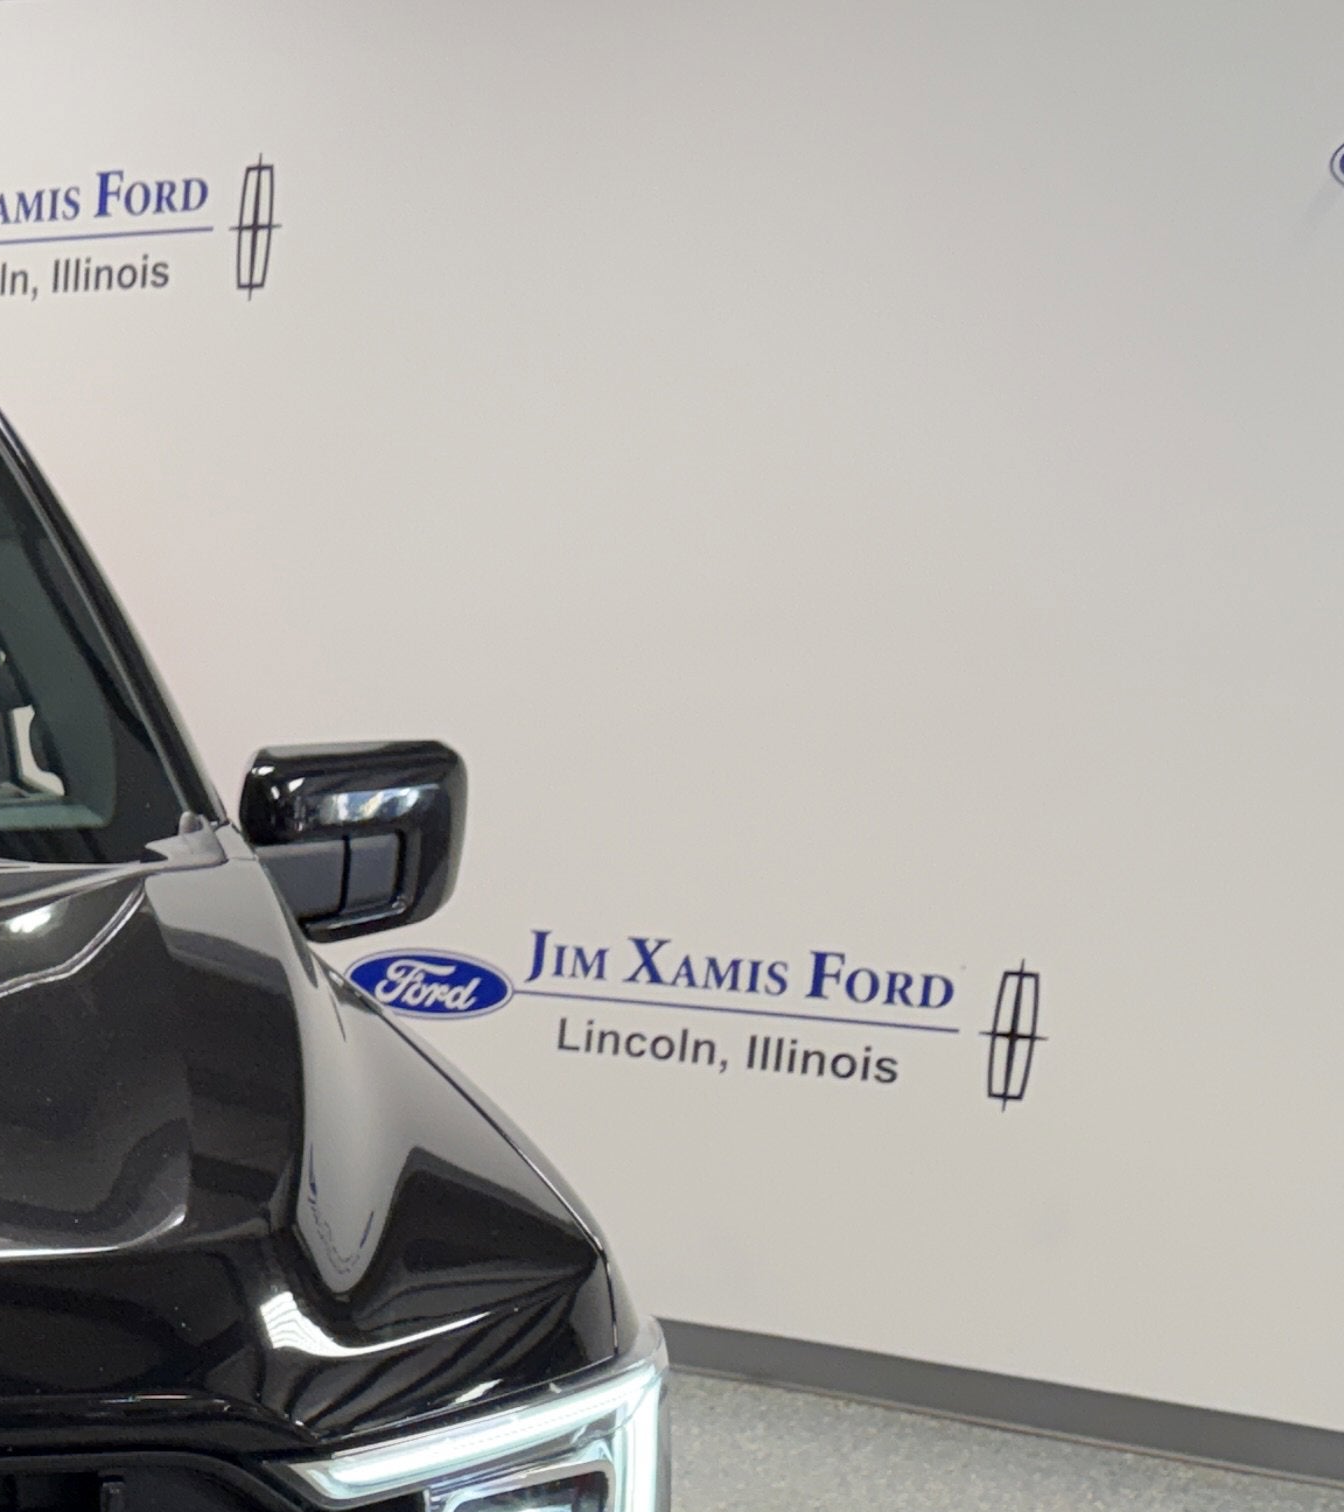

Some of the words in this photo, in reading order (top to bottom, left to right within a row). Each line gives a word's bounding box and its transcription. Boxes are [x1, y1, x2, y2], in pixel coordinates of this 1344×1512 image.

[93, 170, 209, 219] FORD
[51, 254, 170, 294] Illinois
[373, 962, 476, 1012] Ford
[523, 929, 609, 984] JIM
[625, 936, 790, 997] XAMIS
[805, 950, 956, 1010] FORD
[555, 1017, 730, 1074] Lincoln,
[745, 1034, 900, 1085] Illinois
